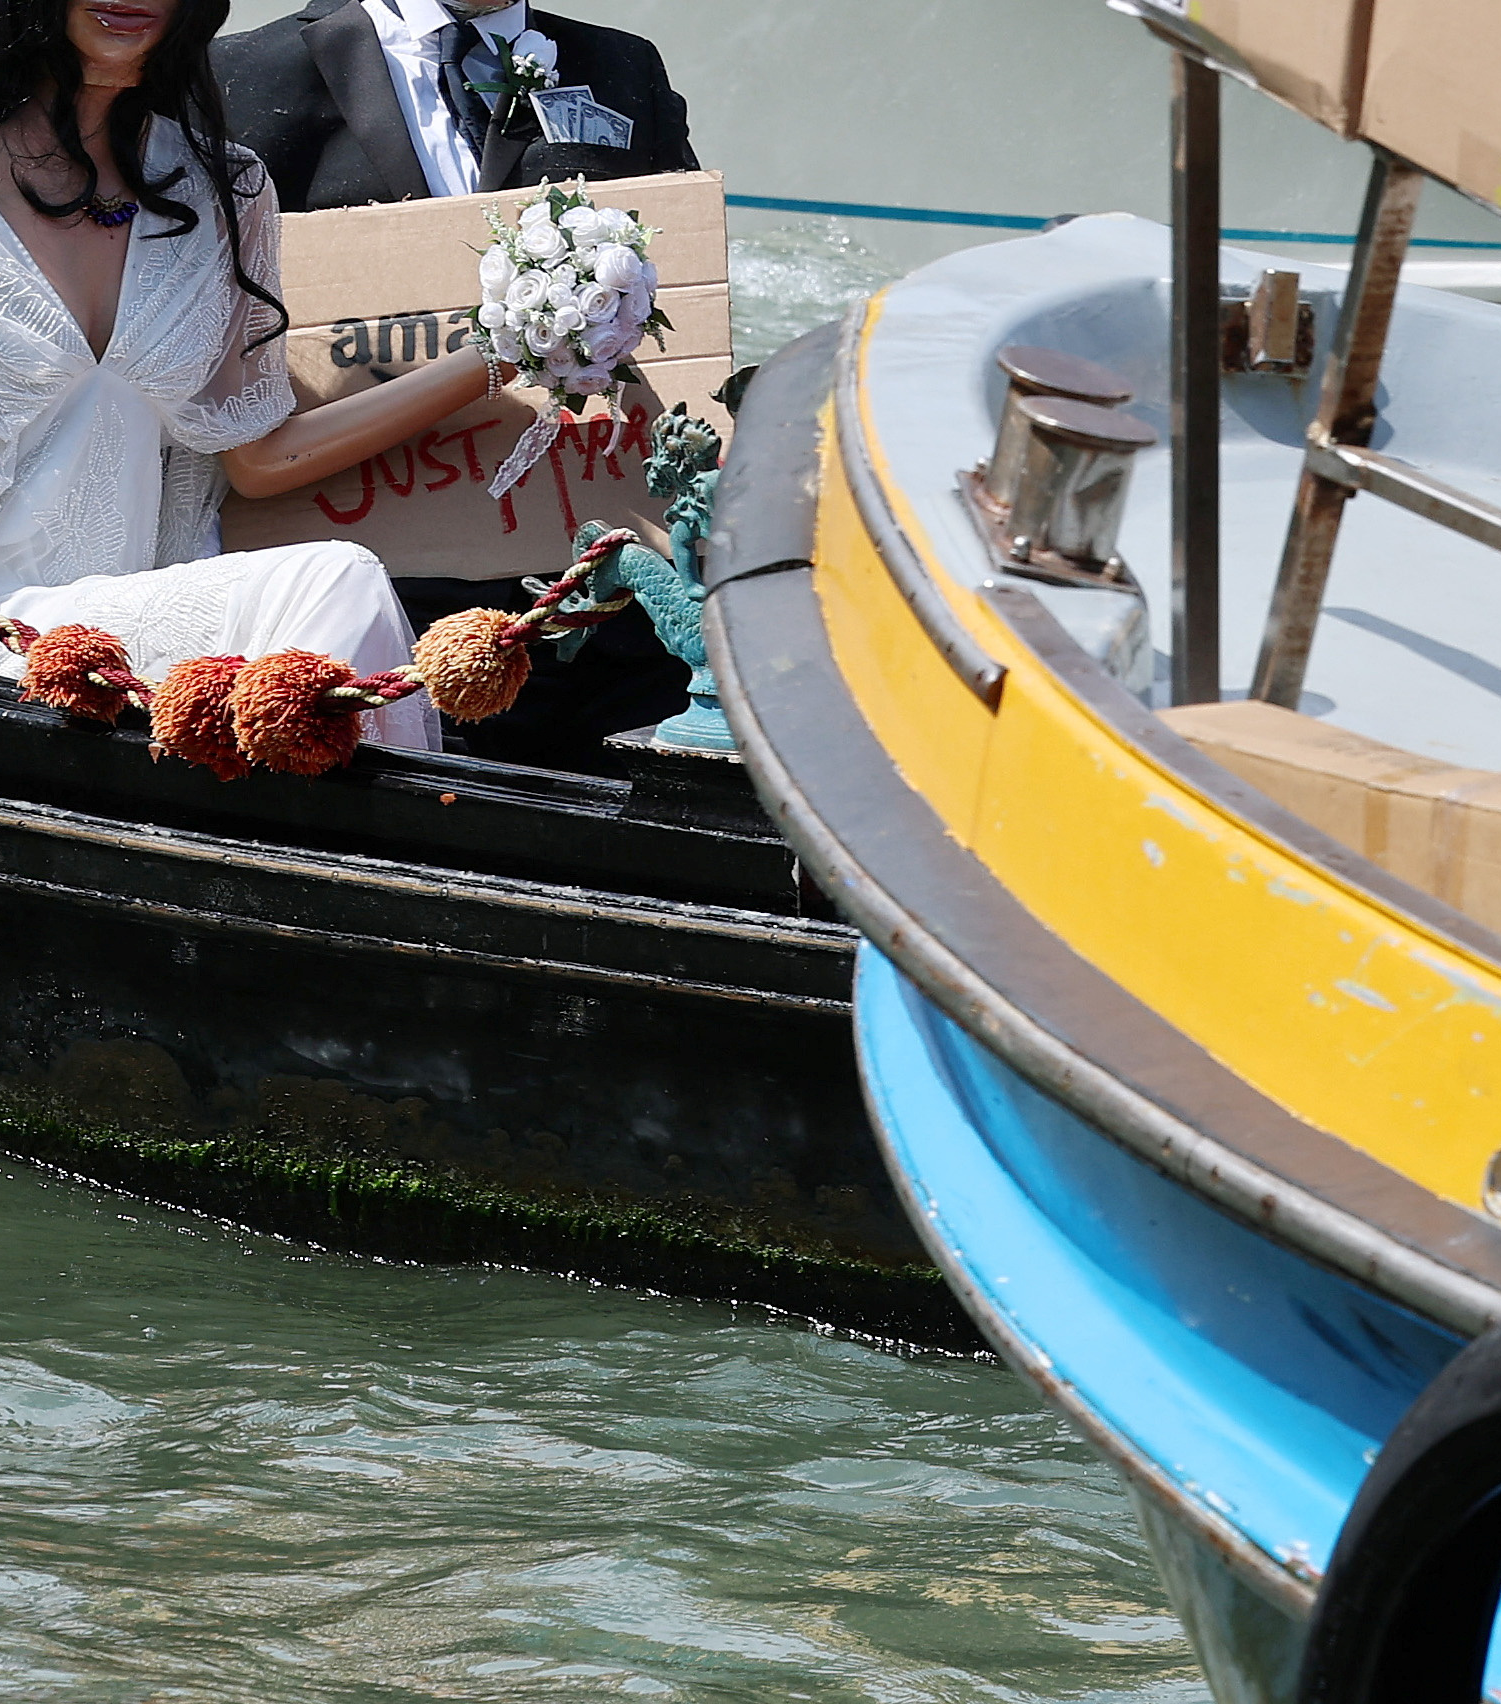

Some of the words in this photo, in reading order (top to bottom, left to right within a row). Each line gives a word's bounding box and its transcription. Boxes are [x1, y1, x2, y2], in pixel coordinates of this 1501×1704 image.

[331, 310, 477, 369] ama
[314, 419, 502, 525] JUST
[496, 402, 653, 543] MARR
